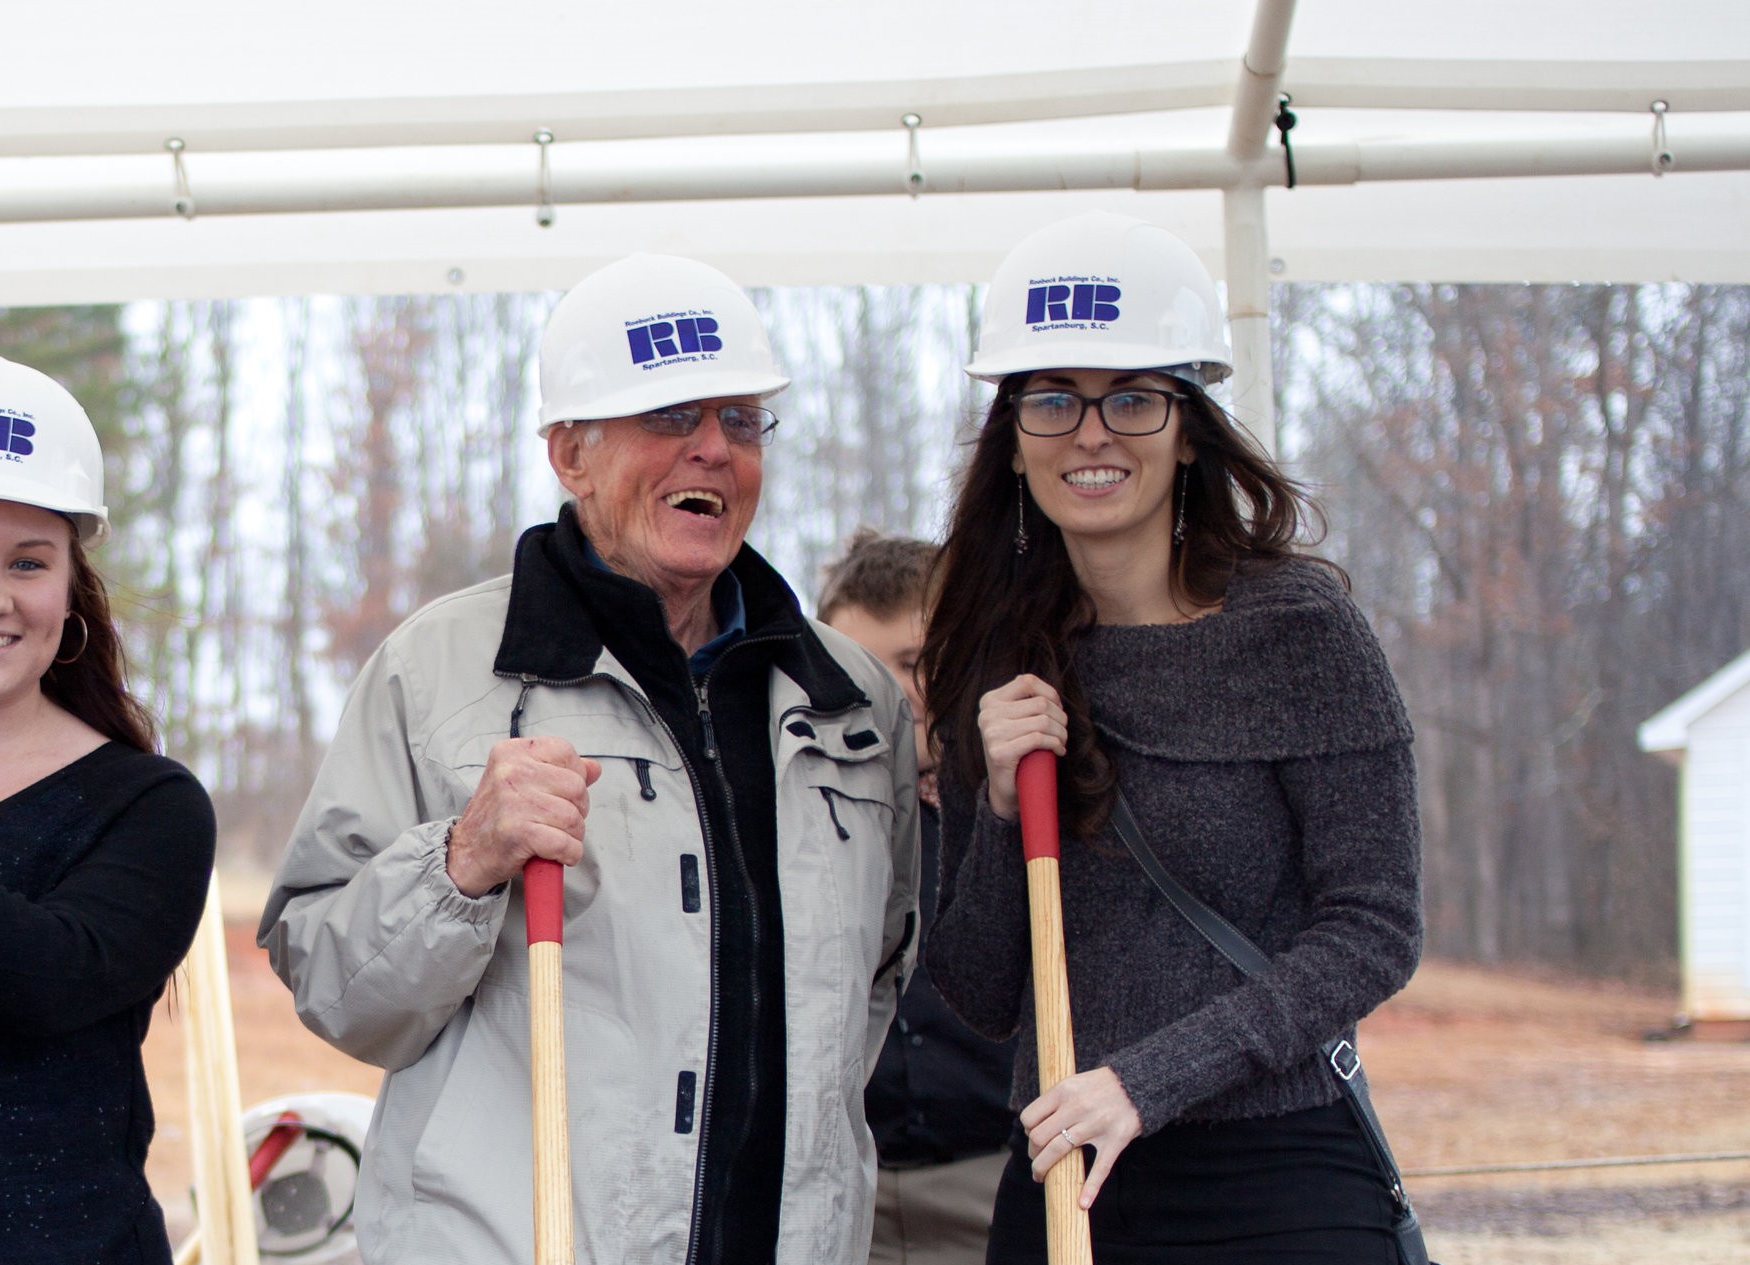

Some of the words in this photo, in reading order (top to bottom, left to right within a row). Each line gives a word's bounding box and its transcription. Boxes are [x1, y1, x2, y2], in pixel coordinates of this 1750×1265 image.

[1026, 284, 1121, 324] RB
[1032, 322, 1087, 332] Spartanburg,
[627, 318, 722, 364] RB
[643, 356, 699, 370] Spartanburg,
[6, 454, 23, 463] S.C.
